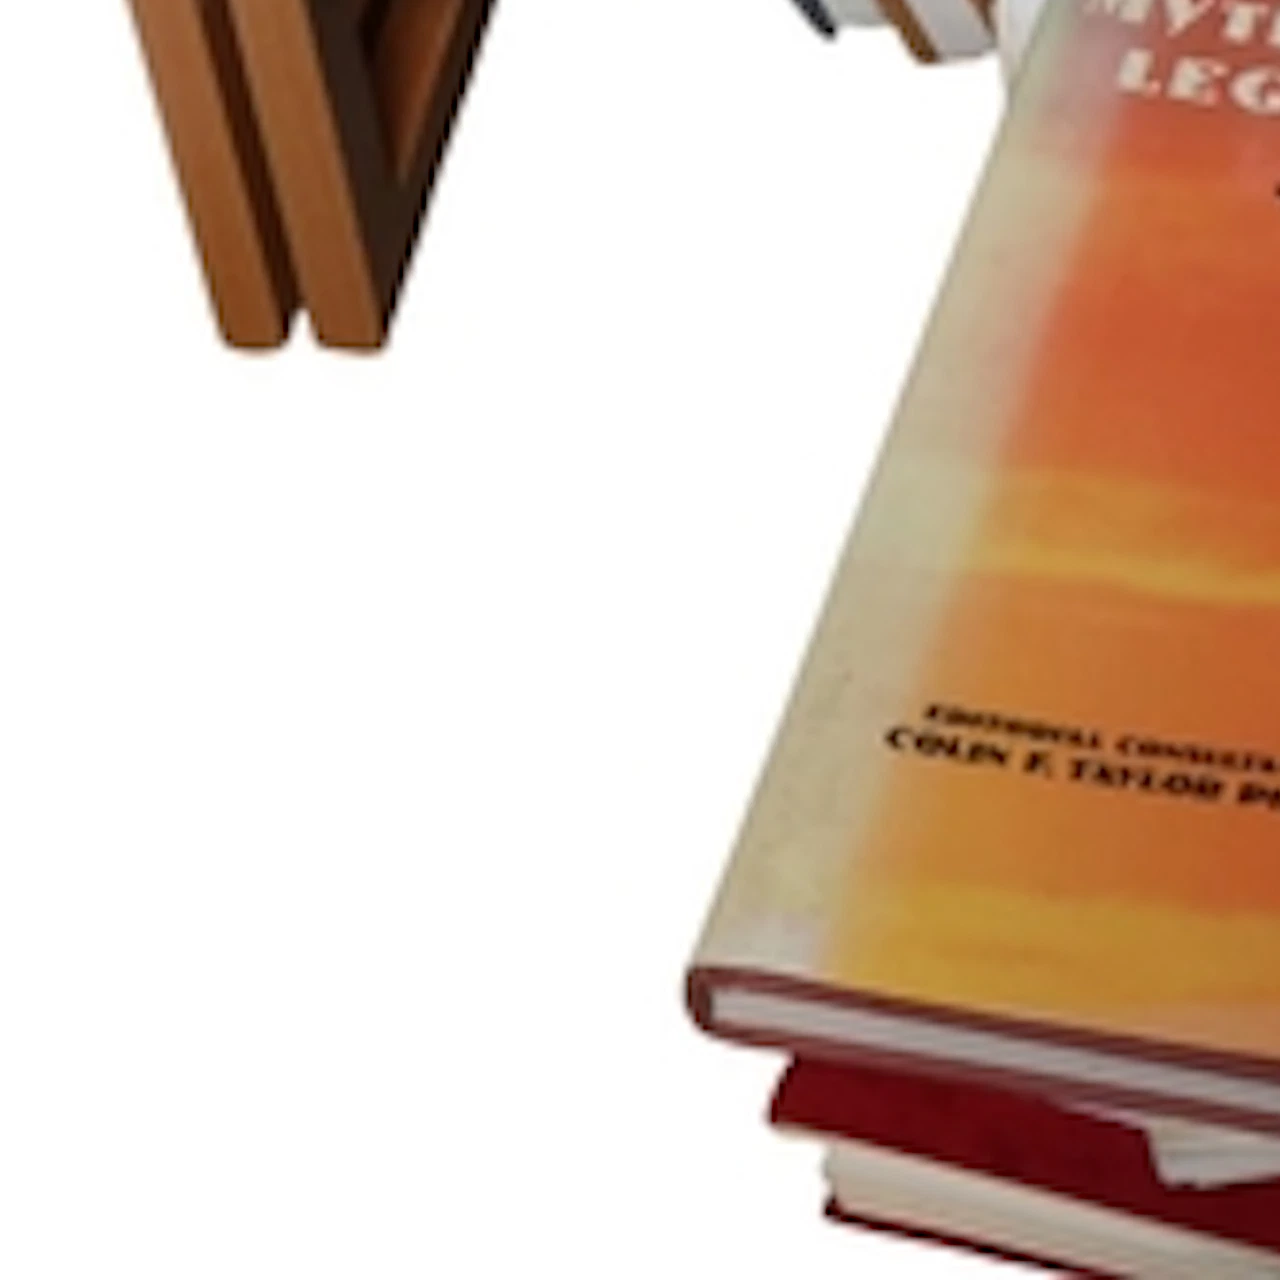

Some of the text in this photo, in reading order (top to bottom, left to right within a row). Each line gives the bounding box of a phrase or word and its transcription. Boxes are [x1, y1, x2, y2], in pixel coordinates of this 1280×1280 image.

[923, 701, 1104, 752] EDITORIAL
[884, 726, 1012, 768] COLIN
[1067, 756, 1228, 803] TAYLOR
